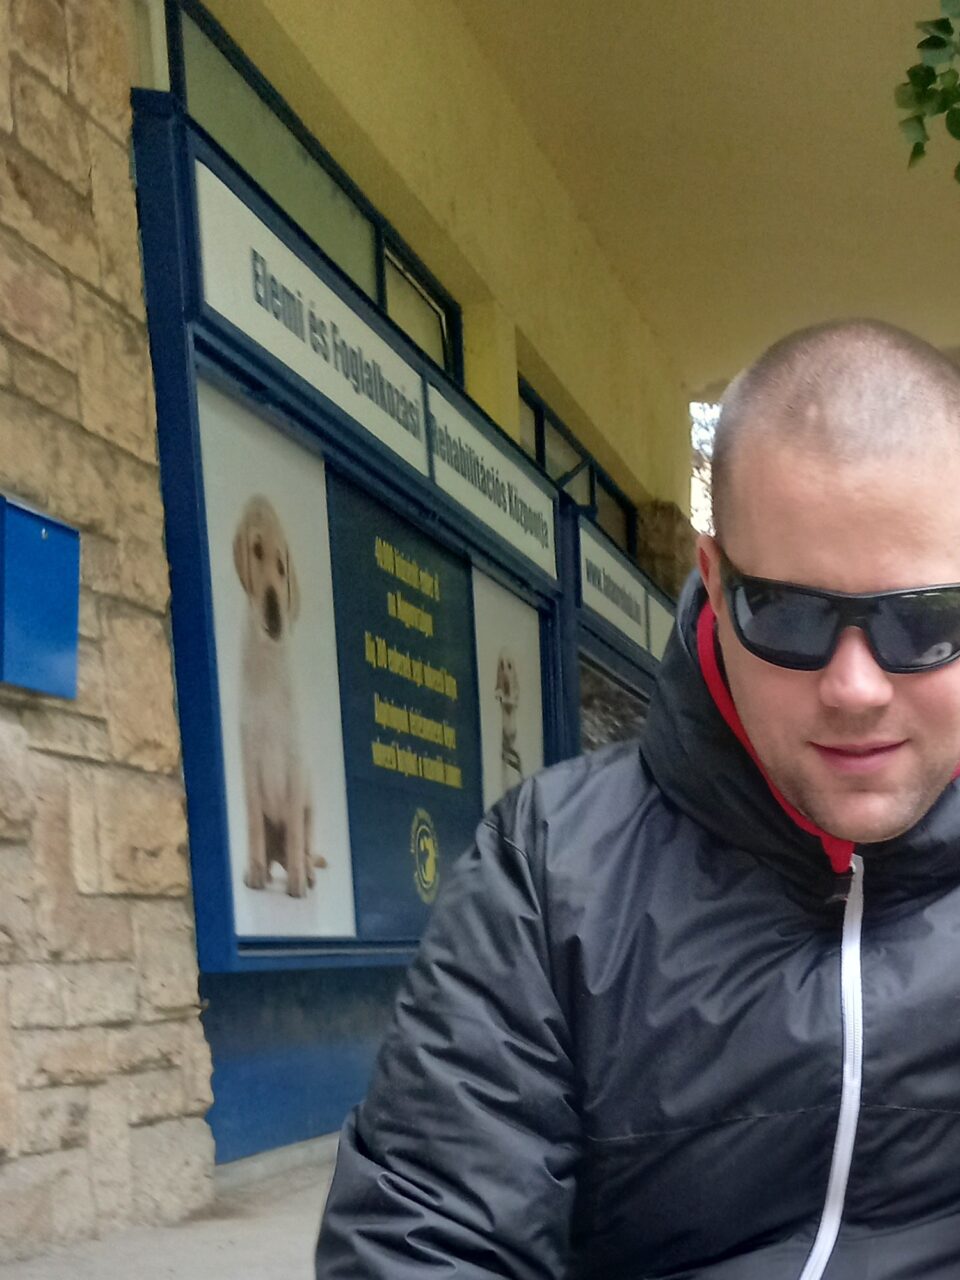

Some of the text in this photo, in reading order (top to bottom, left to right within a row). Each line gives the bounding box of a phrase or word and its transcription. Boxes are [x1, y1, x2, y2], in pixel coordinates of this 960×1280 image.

[252, 247, 306, 344] Elemi
[308, 301, 330, 363] és
[331, 320, 422, 443] Foglalkozási
